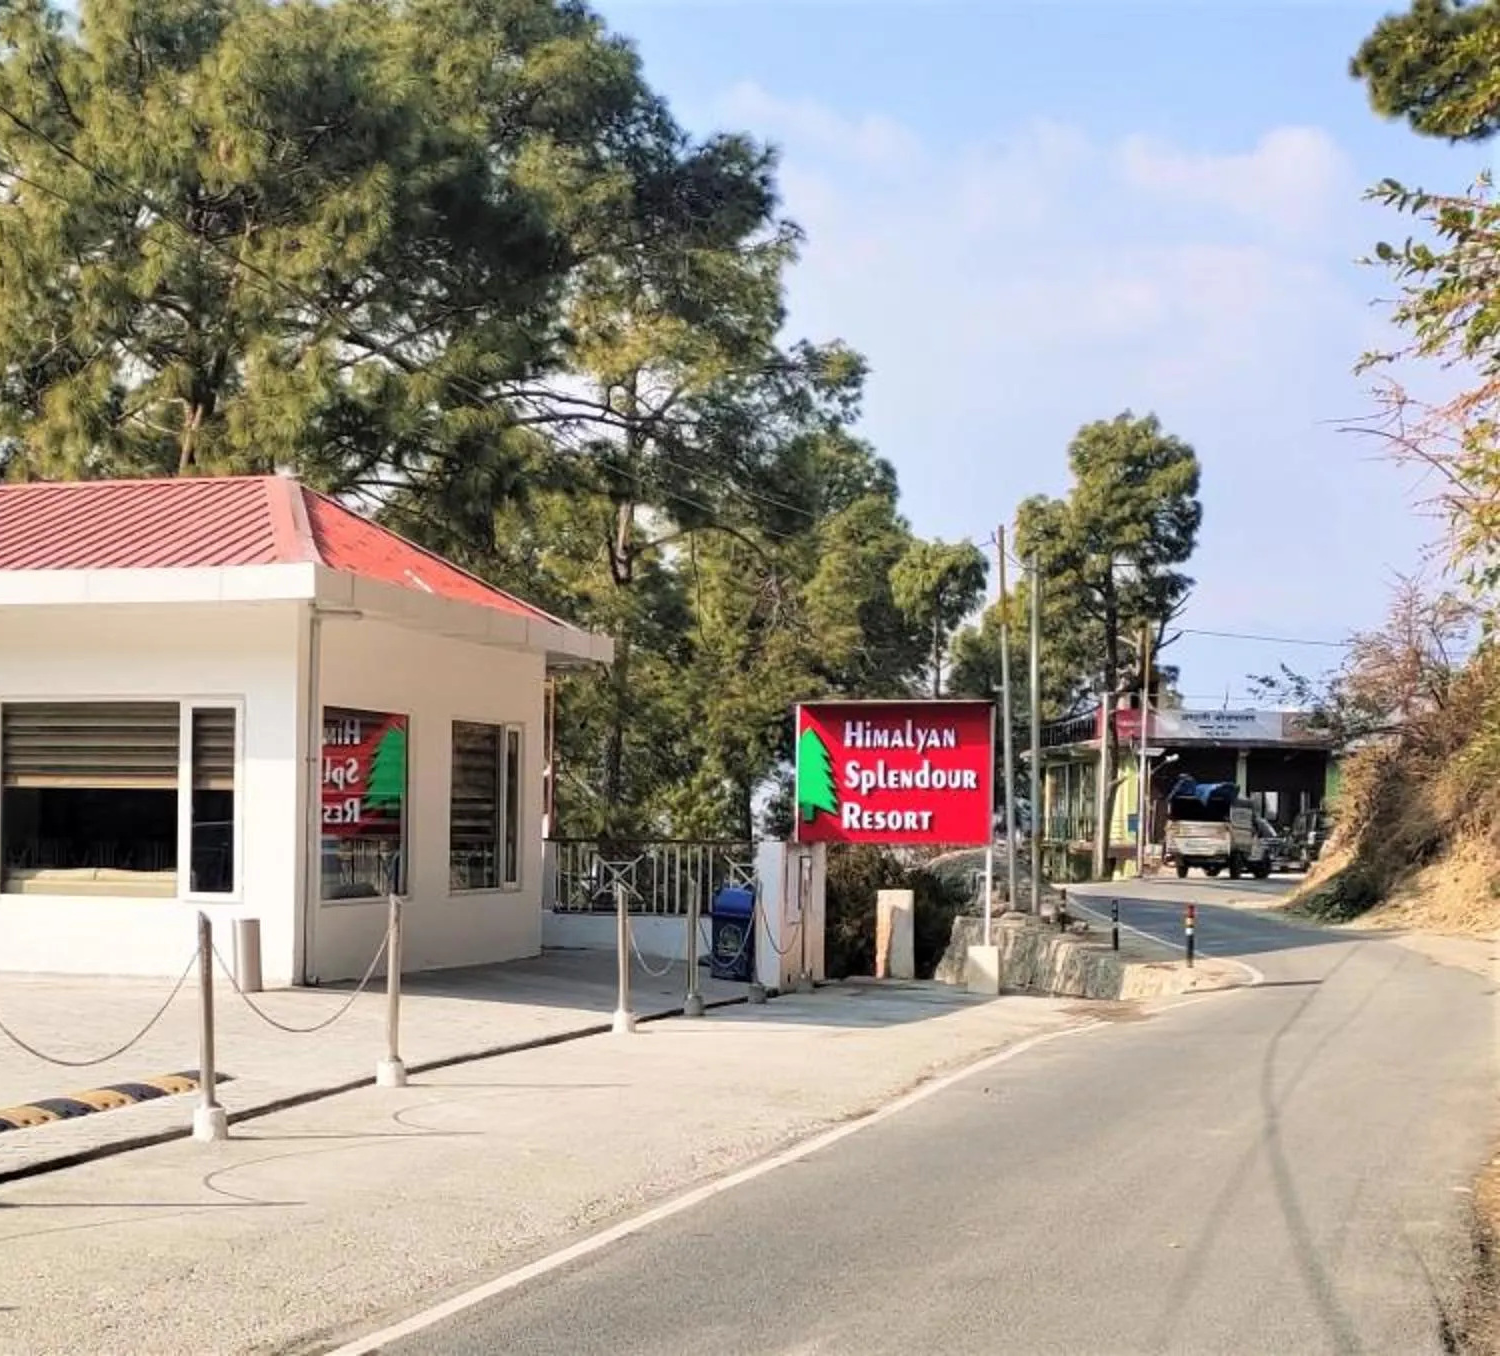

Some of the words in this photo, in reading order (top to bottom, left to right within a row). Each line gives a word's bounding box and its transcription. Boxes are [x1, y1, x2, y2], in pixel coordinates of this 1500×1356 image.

[843, 719, 956, 754] Himalyan
[844, 759, 977, 795] Splendour
[842, 801, 932, 830] Resort
